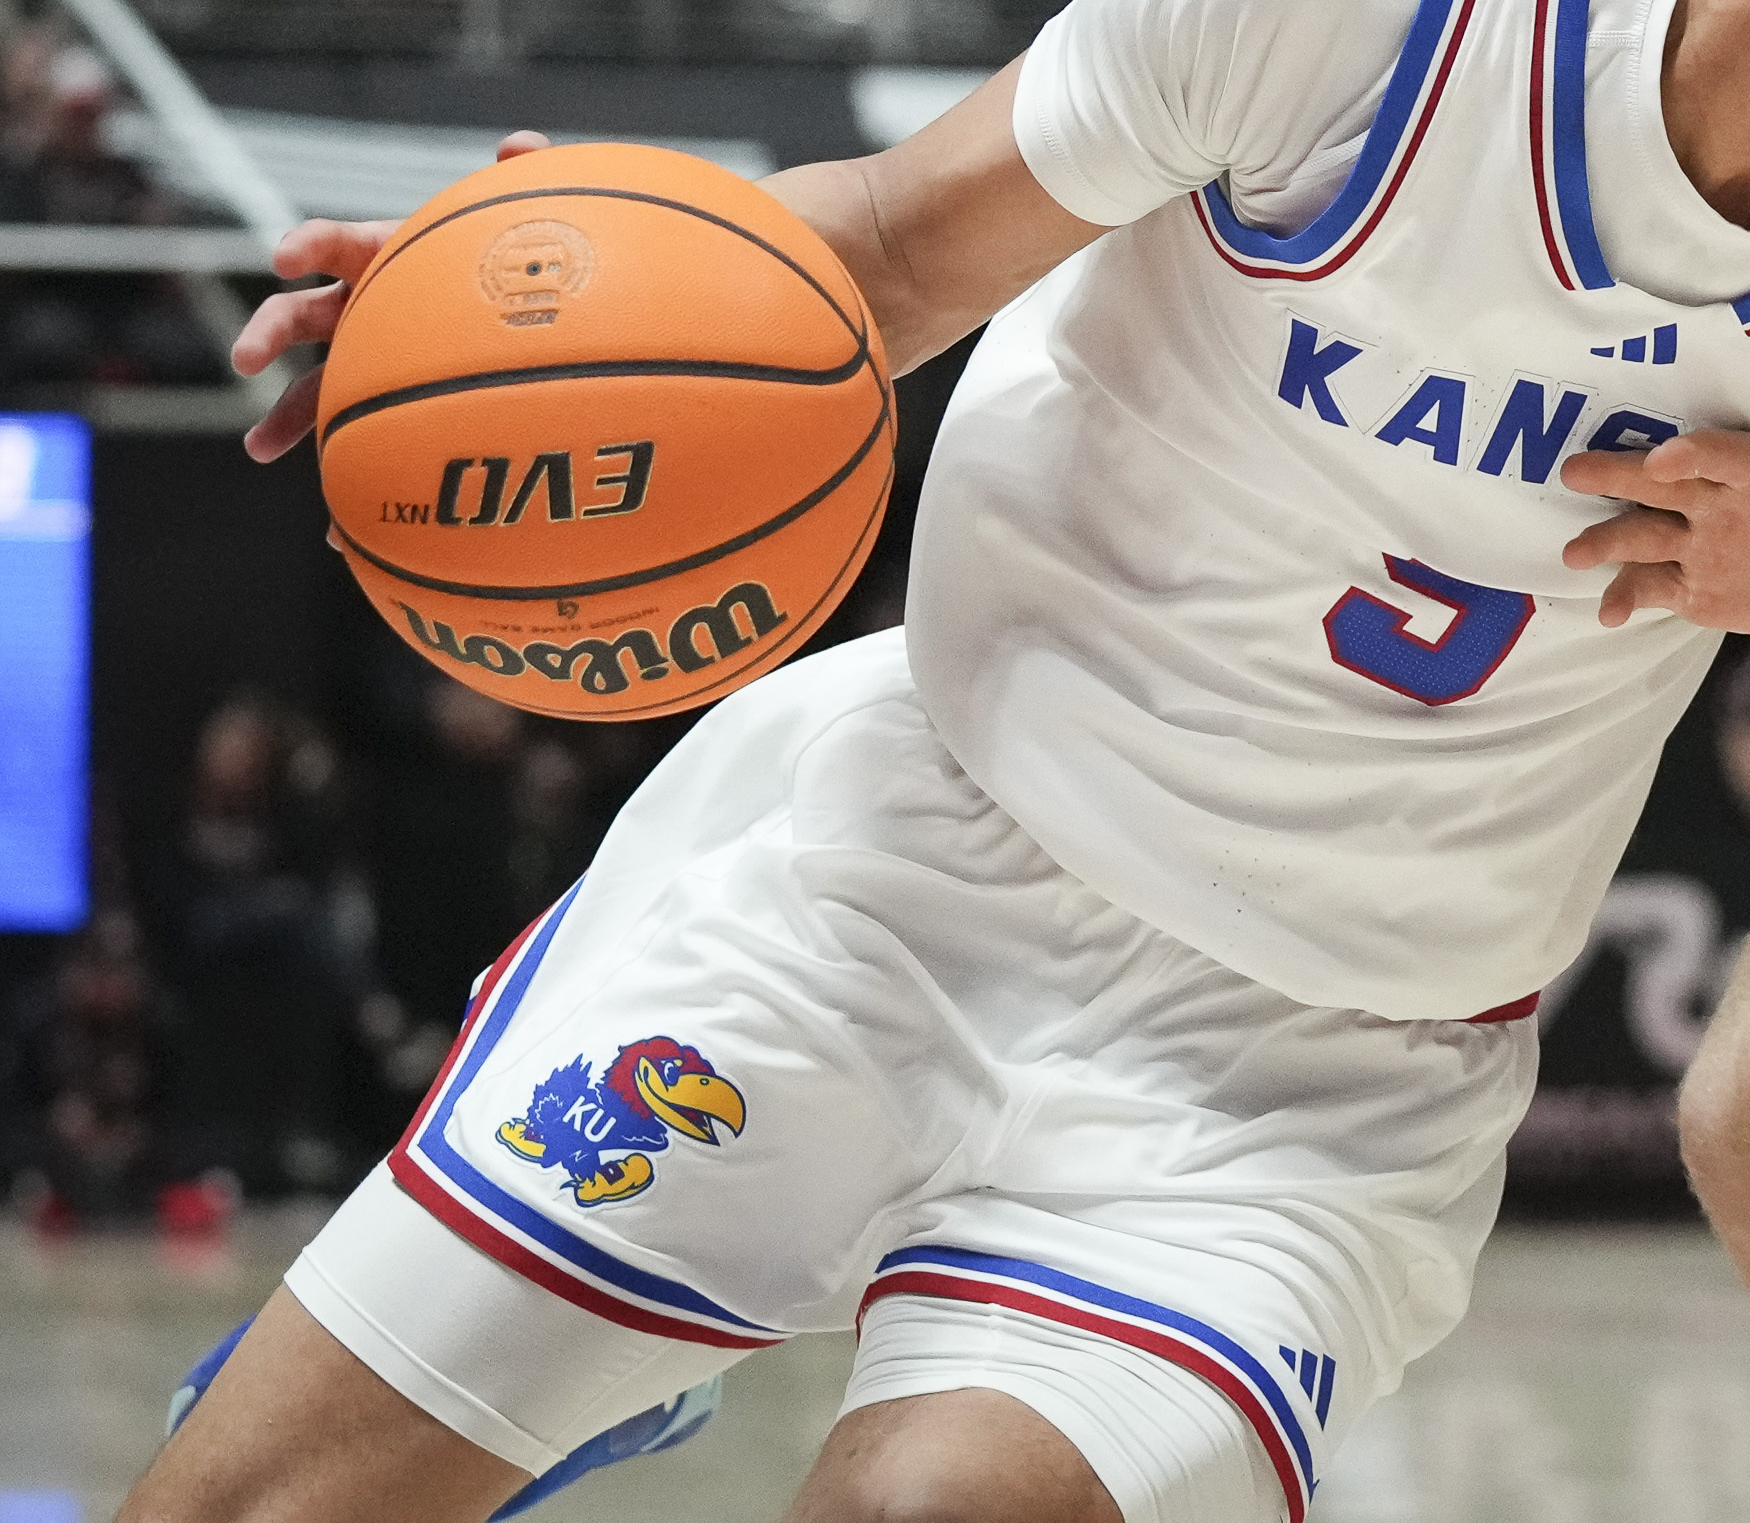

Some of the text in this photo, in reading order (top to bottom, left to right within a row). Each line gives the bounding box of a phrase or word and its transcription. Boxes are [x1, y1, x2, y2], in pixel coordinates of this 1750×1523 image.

[379, 439, 655, 527] EVO NXT
[396, 580, 789, 695] Wilson
[562, 1095, 617, 1143] KU
